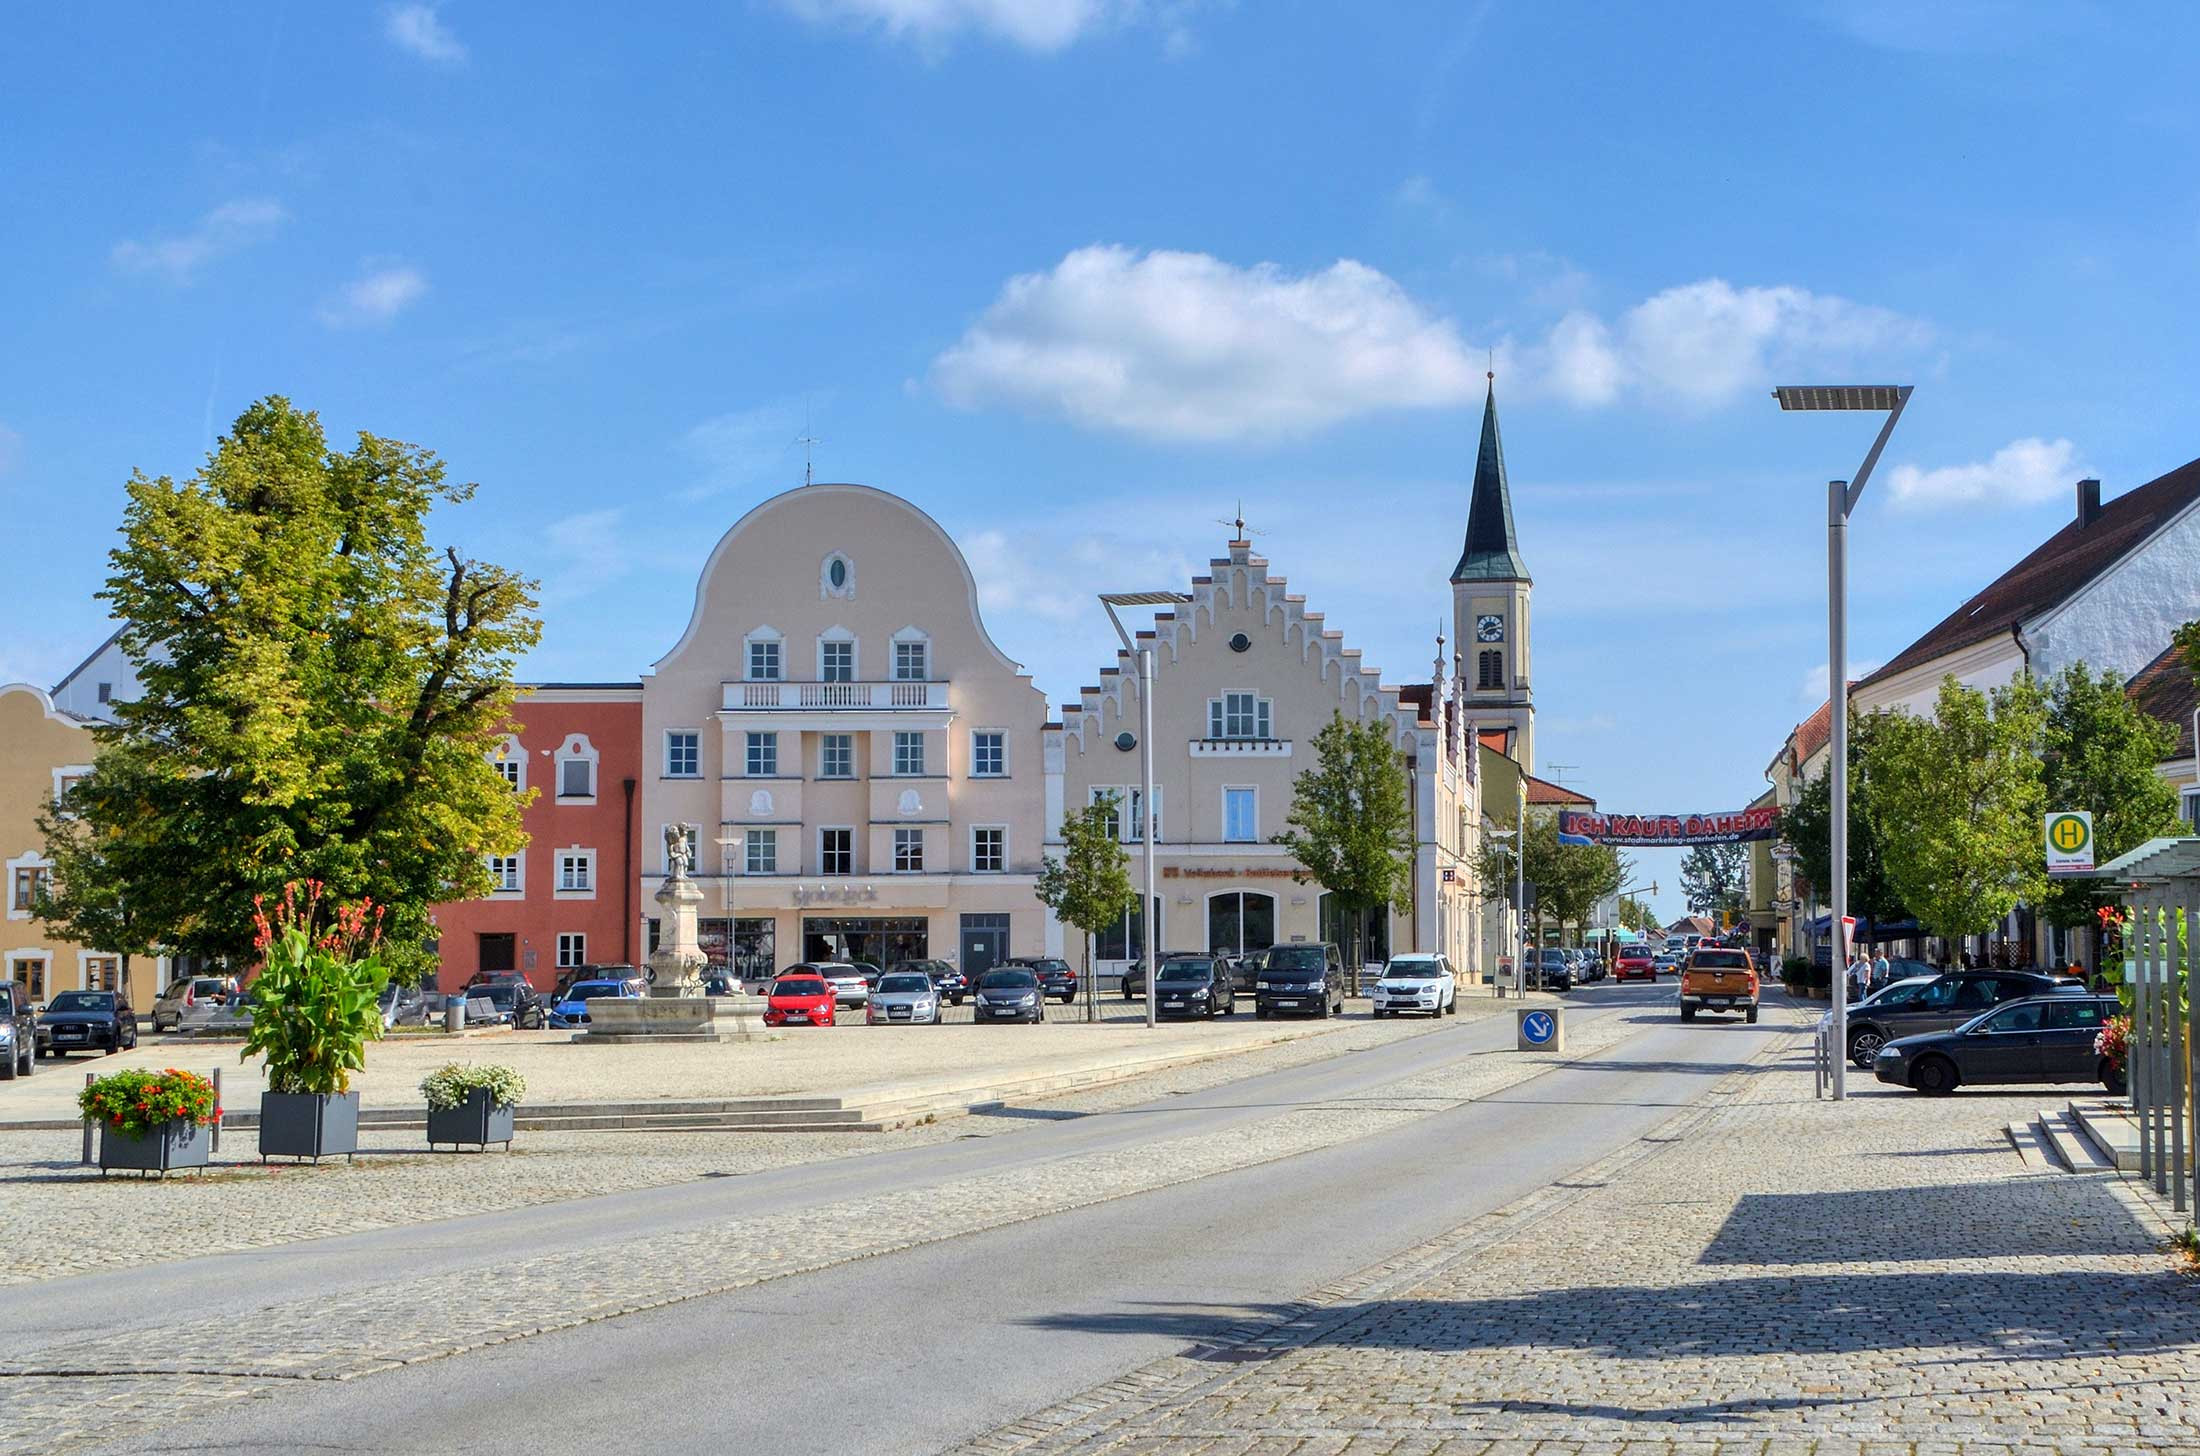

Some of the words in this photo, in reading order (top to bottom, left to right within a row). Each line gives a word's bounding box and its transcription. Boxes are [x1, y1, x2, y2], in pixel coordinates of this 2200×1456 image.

[1568, 815, 1607, 834] ICH
[1611, 817, 1681, 836] KAUFE
[1685, 813, 1773, 834] DAHEIM
[2061, 823, 2077, 845] H
[1602, 833, 1740, 846] www.stadtmarketing-osterhofen.de
